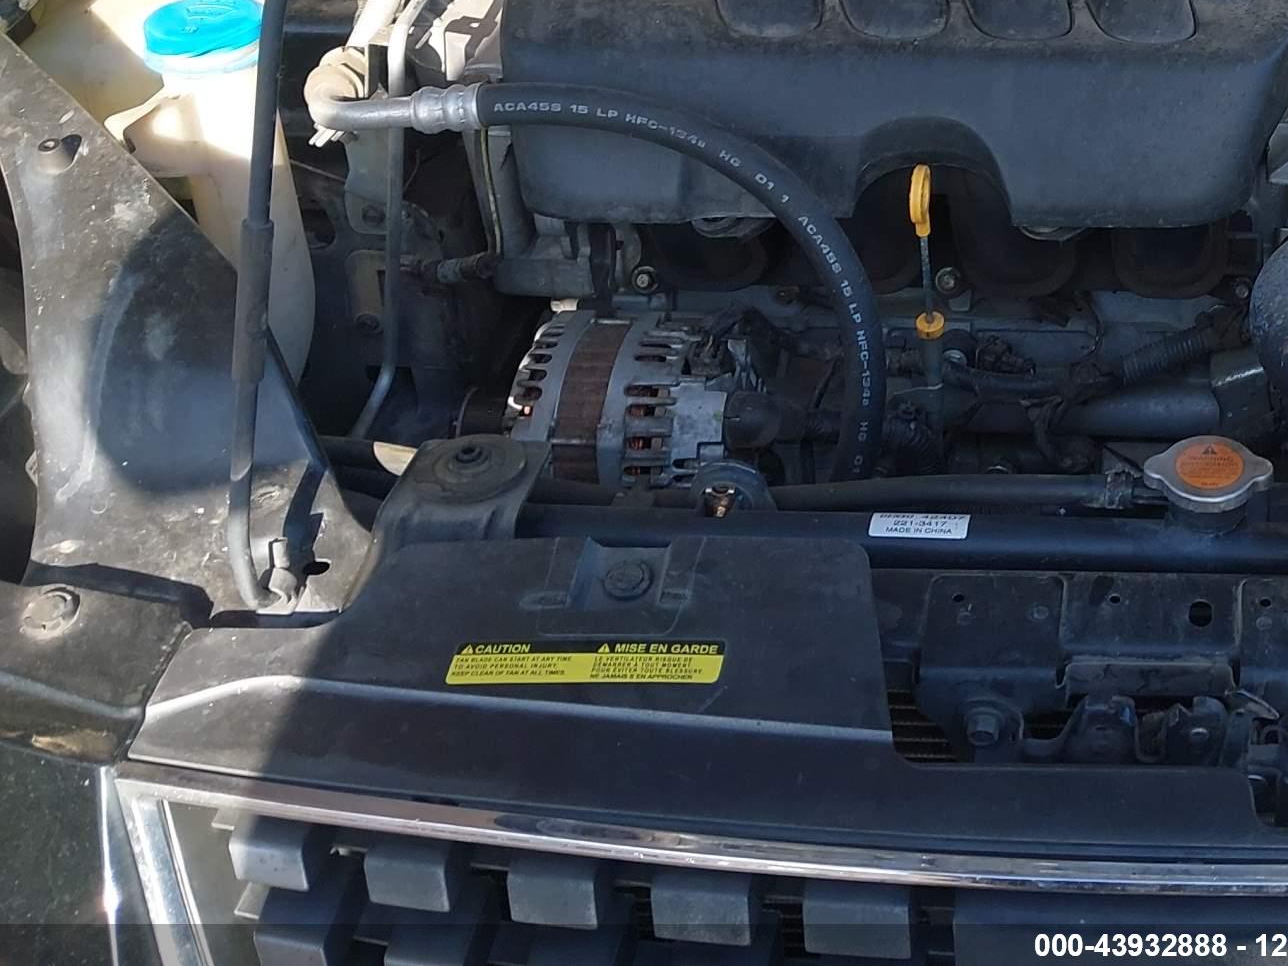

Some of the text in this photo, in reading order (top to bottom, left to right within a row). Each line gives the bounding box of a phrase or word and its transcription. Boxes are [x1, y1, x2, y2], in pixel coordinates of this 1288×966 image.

[569, 104, 588, 114] 15
[596, 107, 618, 119] LP
[840, 279, 853, 297] 15
[848, 303, 862, 323] LP
[924, 527, 952, 535] CHINA
[474, 643, 531, 654] CAUTION
[614, 643, 719, 654] MISE EN GARDE
